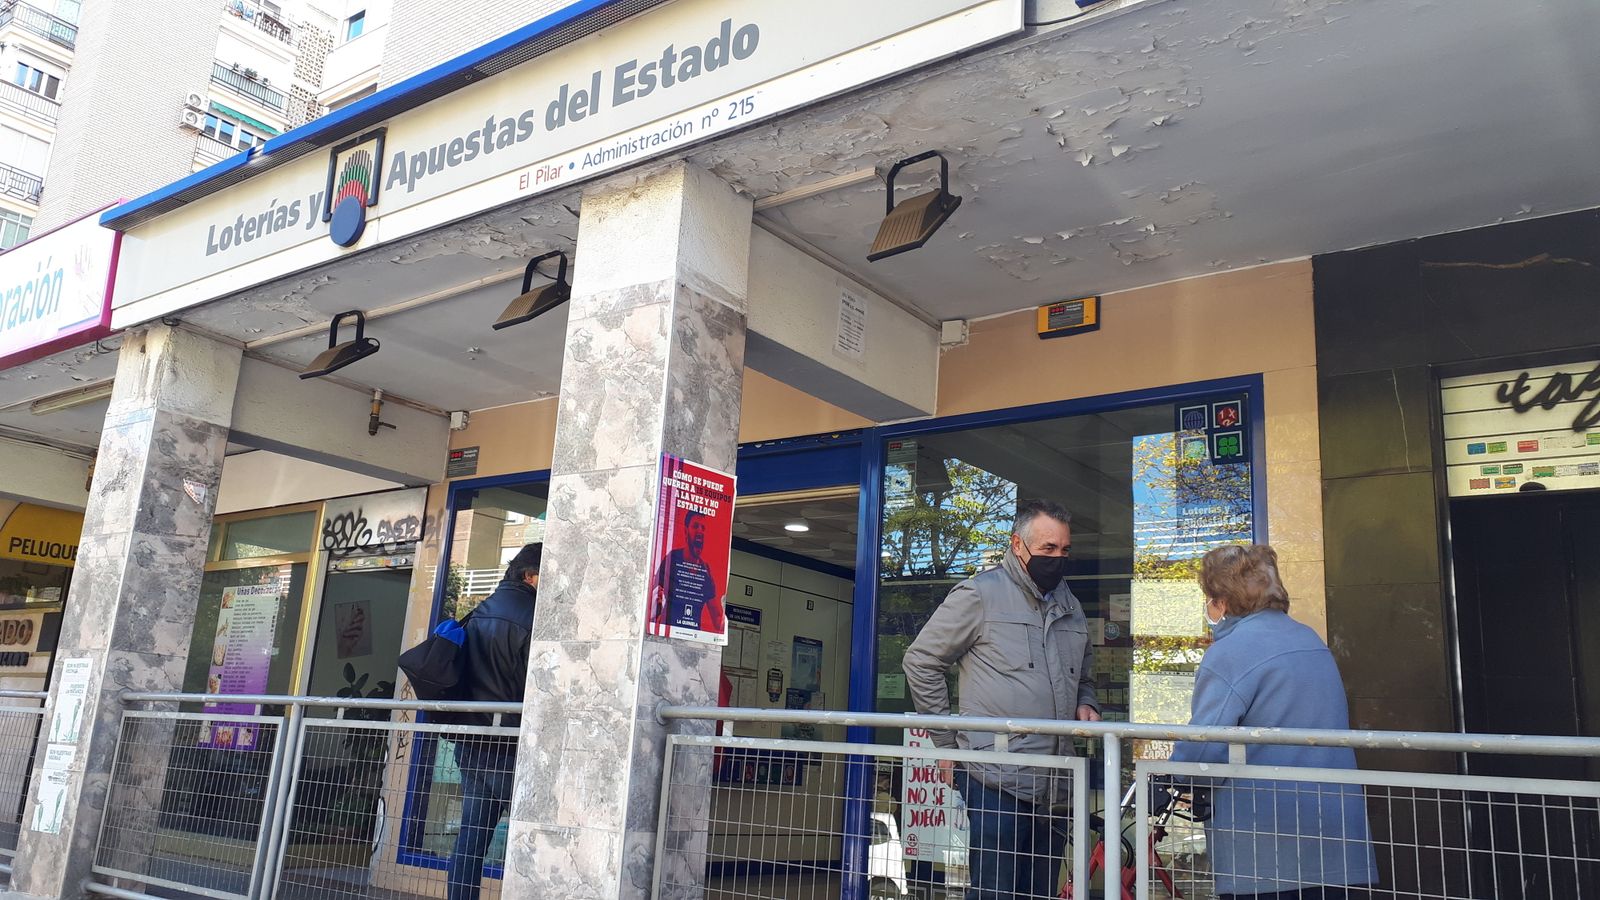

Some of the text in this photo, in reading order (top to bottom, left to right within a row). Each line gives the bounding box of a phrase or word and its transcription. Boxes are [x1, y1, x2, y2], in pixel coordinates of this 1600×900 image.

[205, 18, 760, 257] Loterías y Apuestas del Estado
[519, 172, 530, 191] El
[535, 163, 564, 186] Pilar
[581, 118, 693, 170] Administración
[728, 96, 755, 121] 215
[0, 255, 64, 333] ración
[663, 477, 690, 491] QUERER
[690, 484, 696, 493] A
[704, 489, 732, 503] EQUIPOS
[673, 469, 724, 492] CÓMO SE PUEDE
[675, 489, 719, 509] A LA VEZ Y NO
[677, 499, 716, 517] ESTAR LOCO
[907, 787, 946, 806] NO SE
[907, 809, 946, 828] JUEGA
